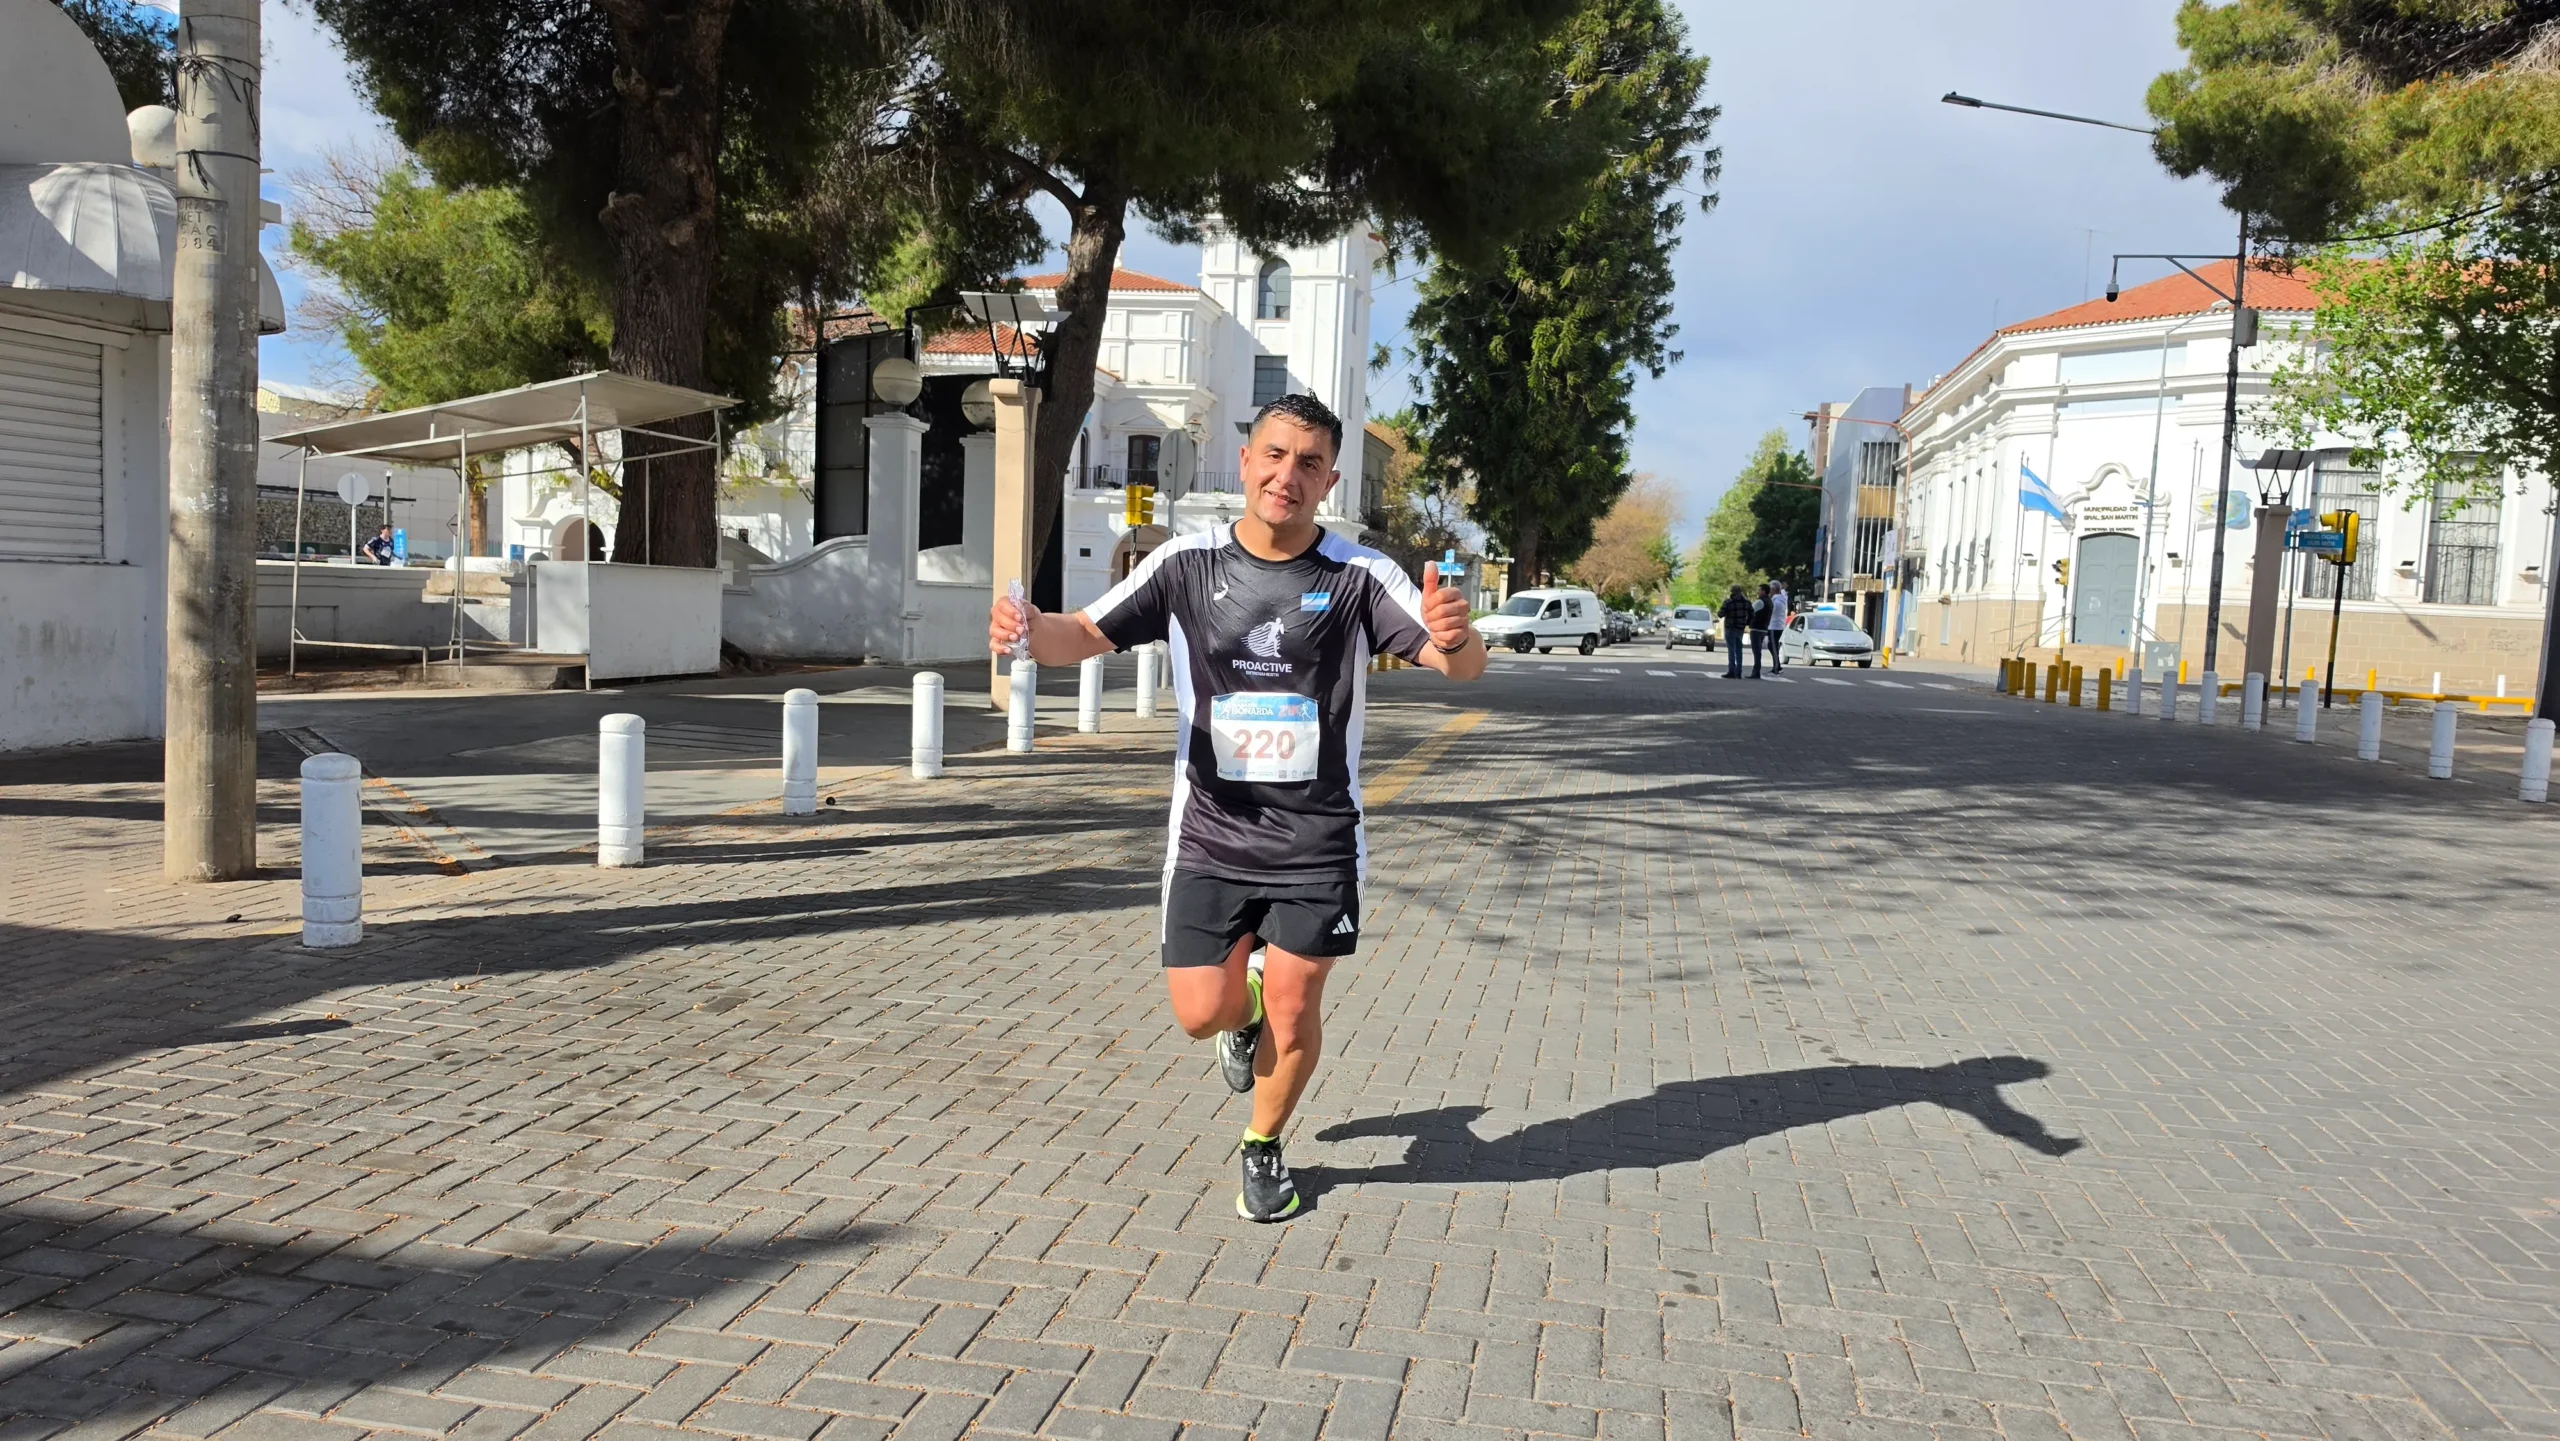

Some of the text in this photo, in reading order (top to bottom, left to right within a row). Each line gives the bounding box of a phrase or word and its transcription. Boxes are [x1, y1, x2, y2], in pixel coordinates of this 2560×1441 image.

[1232, 659, 1293, 673] PROACTIVE
[1231, 706, 1275, 716] BONARDA
[1232, 728, 1296, 760] 220
